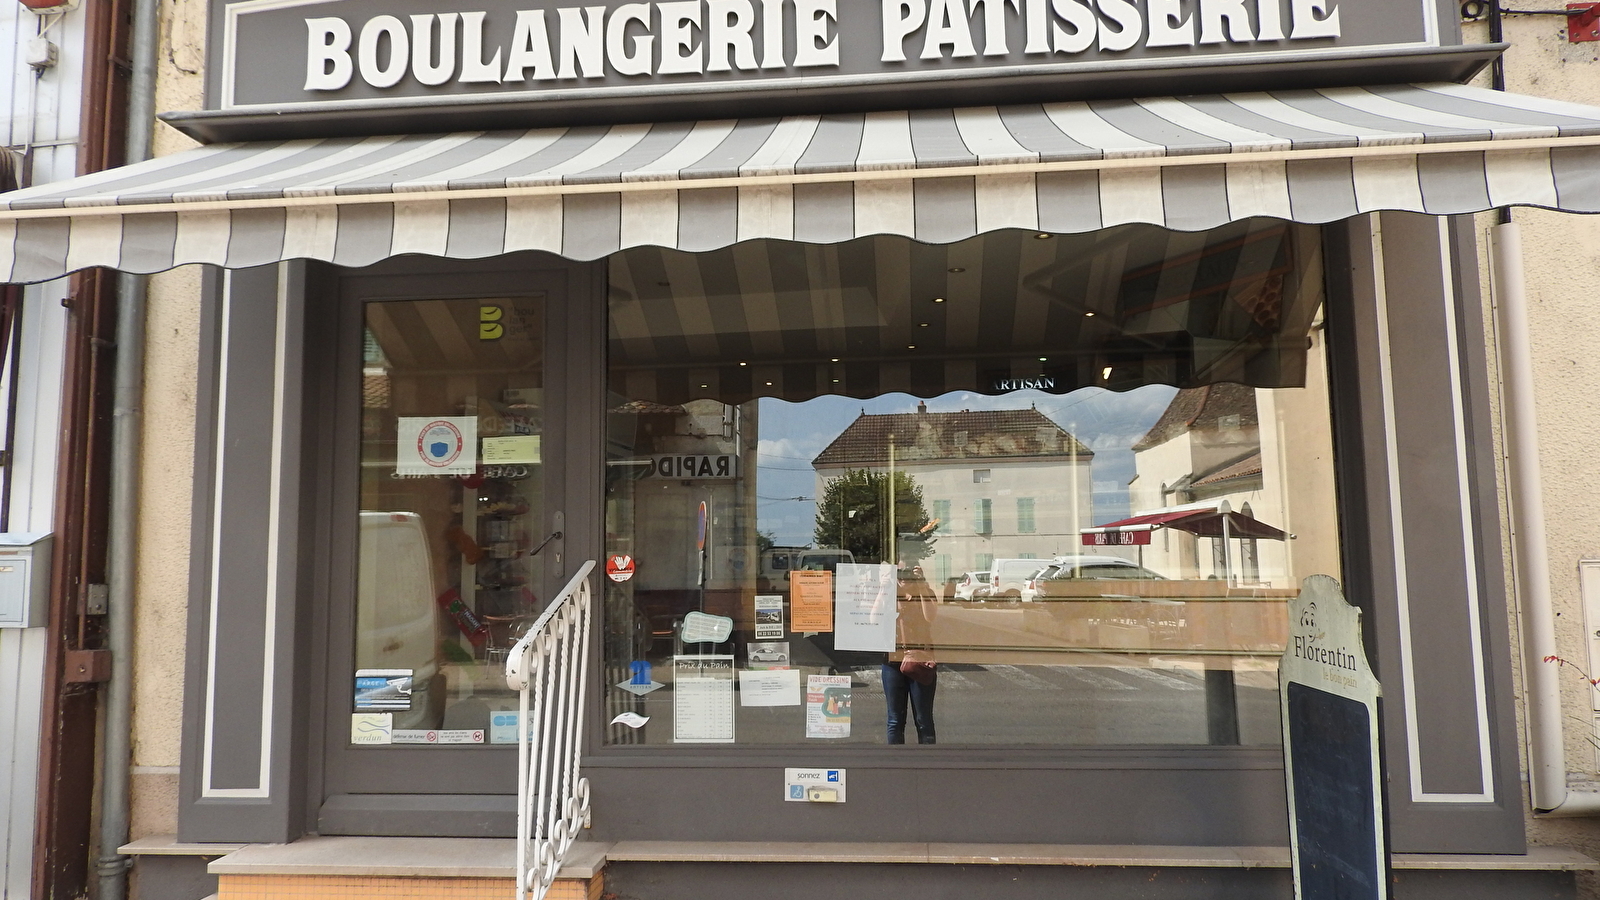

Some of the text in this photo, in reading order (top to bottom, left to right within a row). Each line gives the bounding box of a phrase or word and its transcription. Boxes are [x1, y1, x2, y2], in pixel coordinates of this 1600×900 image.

[303, 0, 841, 91] BOULANGERIE
[1294, 635, 1357, 671] Florentin
[679, 661, 730, 669] Prix du Pain
[822, 676, 849, 684] DRESSING
